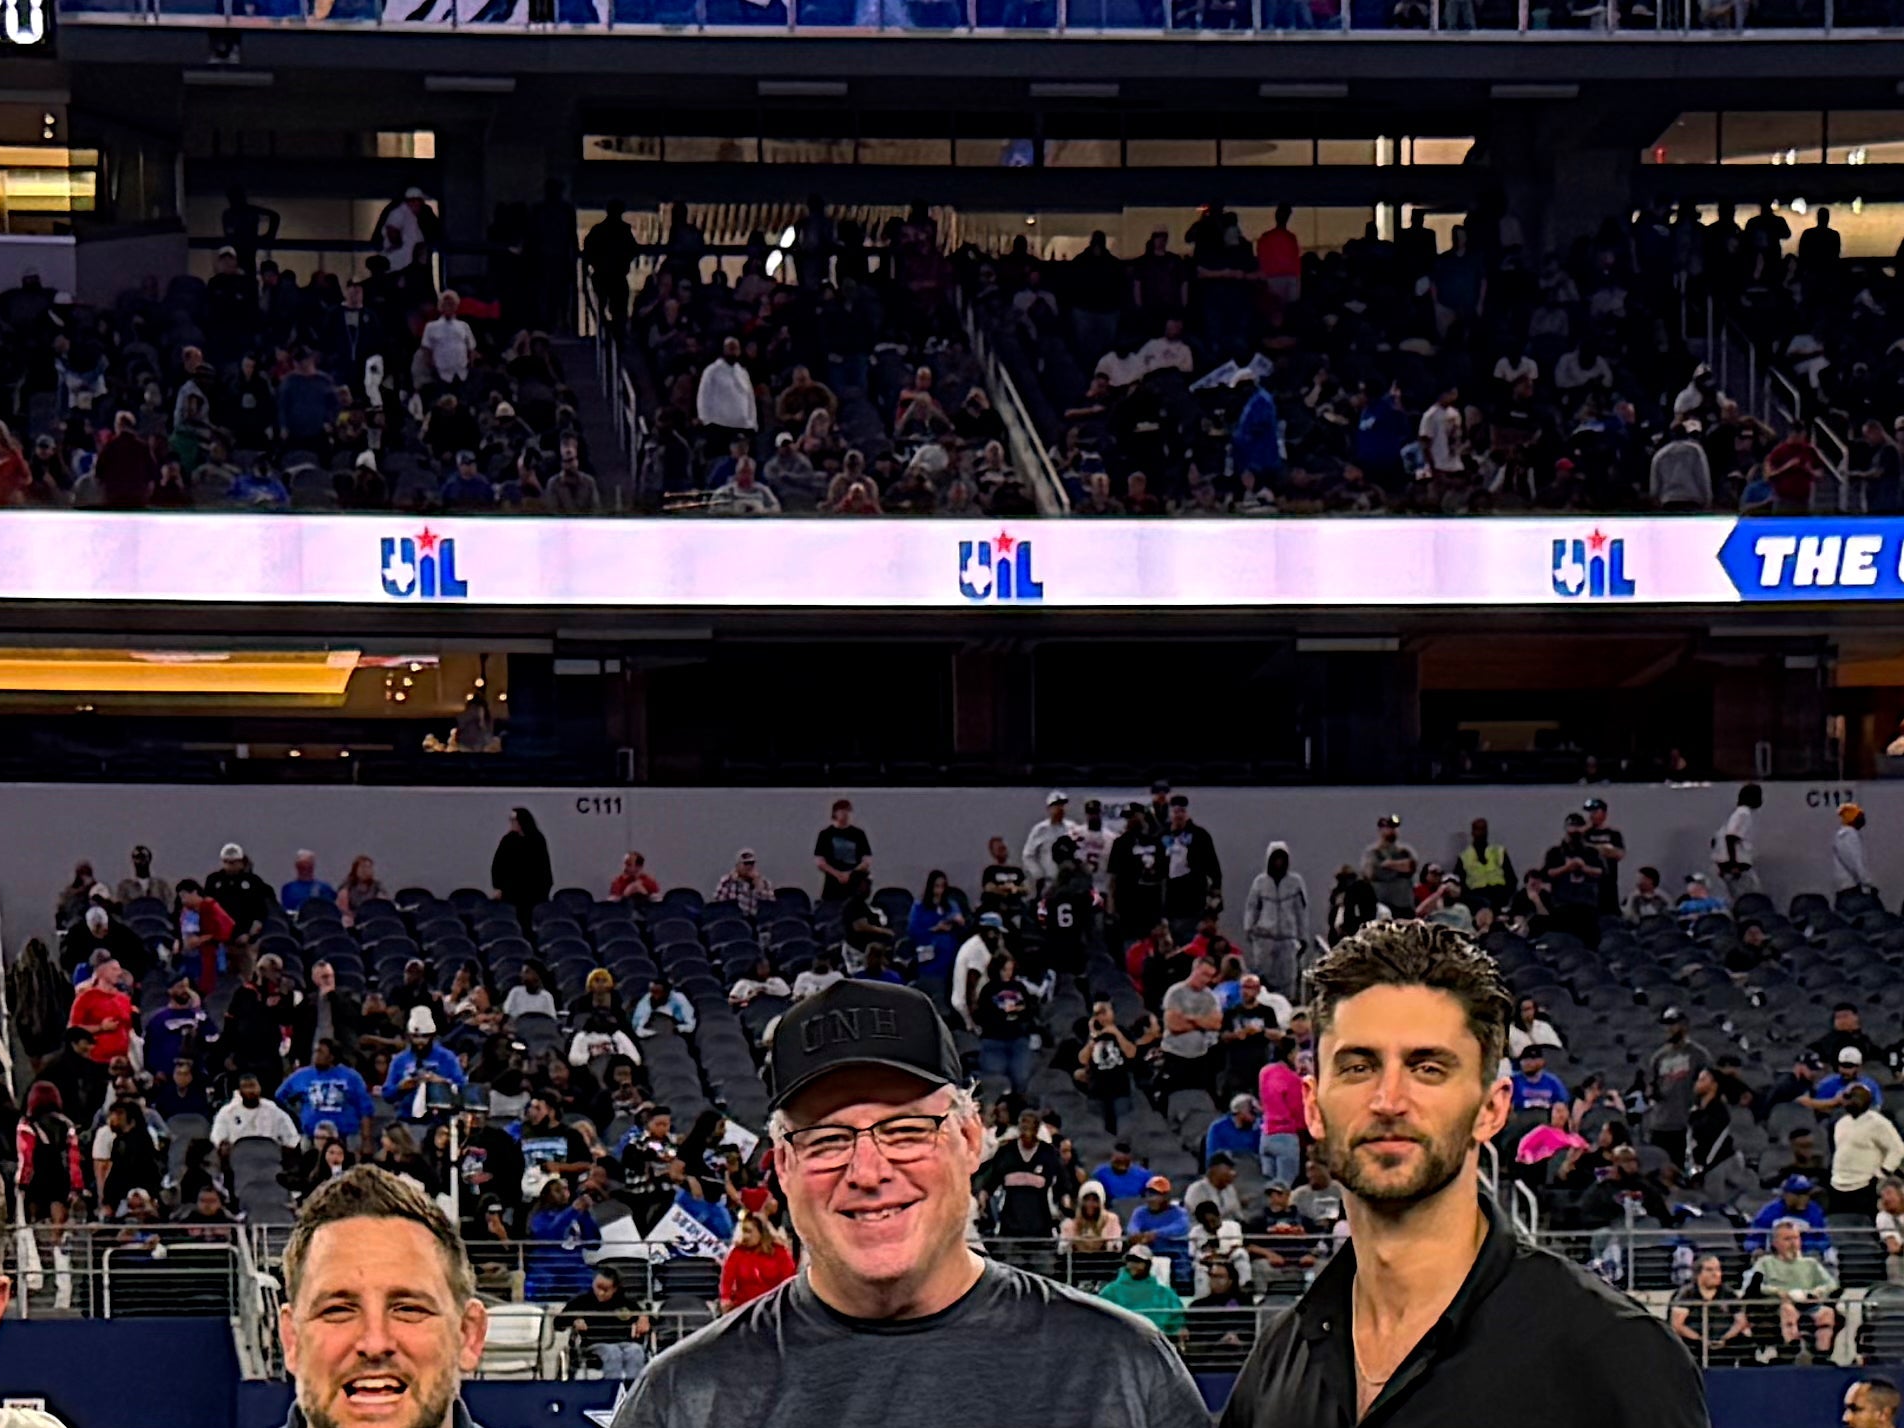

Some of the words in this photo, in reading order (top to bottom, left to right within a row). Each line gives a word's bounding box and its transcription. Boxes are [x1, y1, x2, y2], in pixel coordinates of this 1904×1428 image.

[380, 526, 468, 599] UIL
[958, 530, 1043, 600] UIL
[1551, 528, 1635, 598] UIL
[1755, 536, 1879, 587] THE
[576, 796, 622, 814] C111
[1056, 902, 1074, 928] 6
